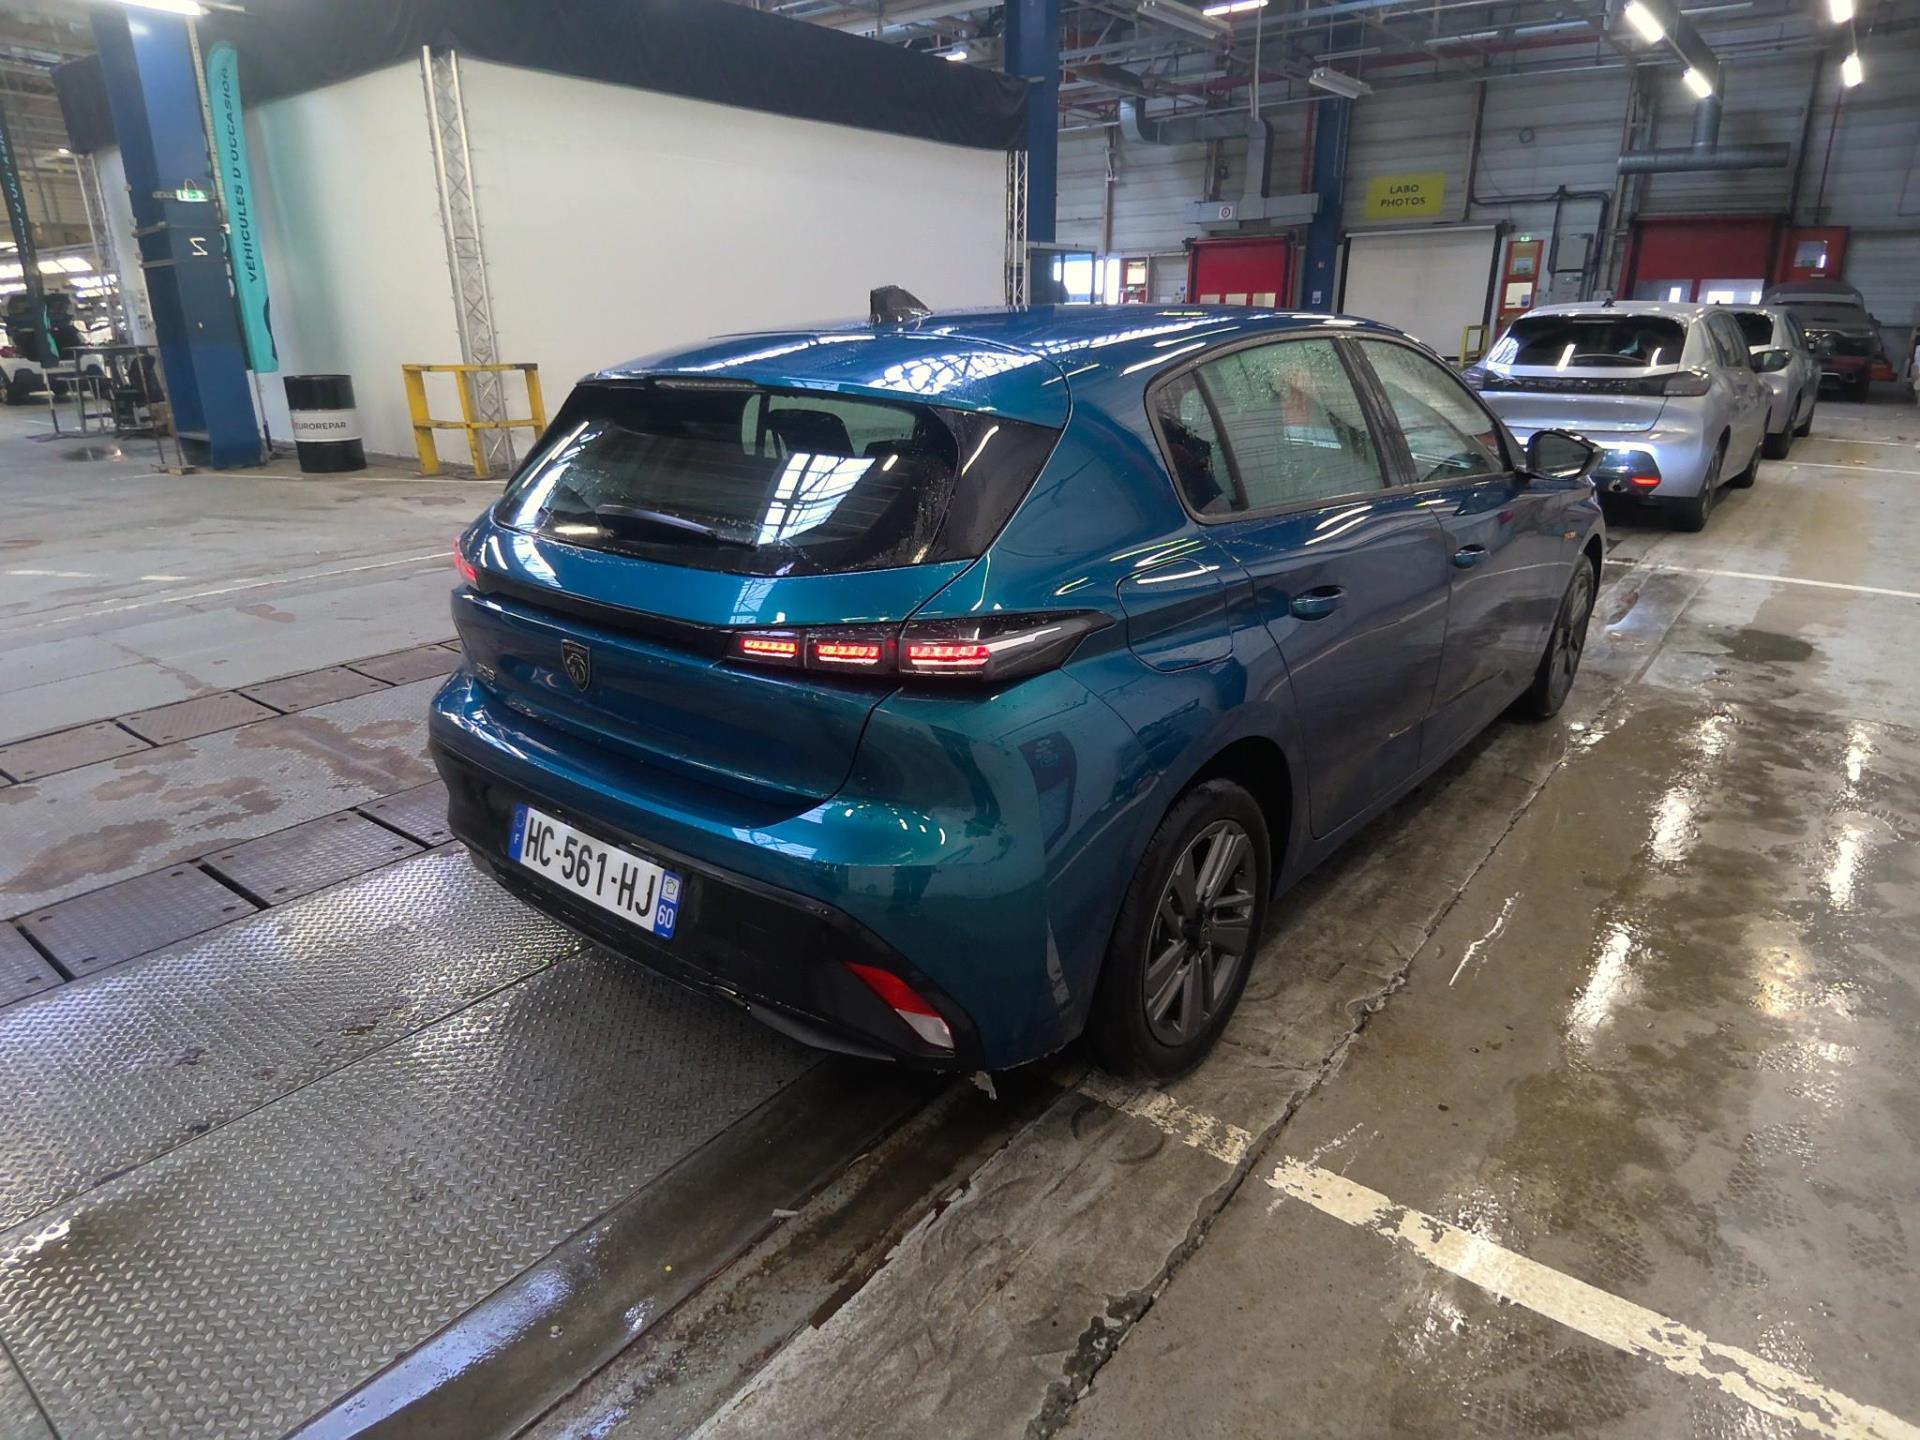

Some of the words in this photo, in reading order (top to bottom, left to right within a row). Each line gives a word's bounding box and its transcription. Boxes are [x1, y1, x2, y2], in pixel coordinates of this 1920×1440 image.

[1390, 184, 1420, 194] LABO
[1380, 196, 1427, 208] PHOTOS
[525, 817, 657, 917] HC-561-HJ
[656, 904, 675, 930] 60
